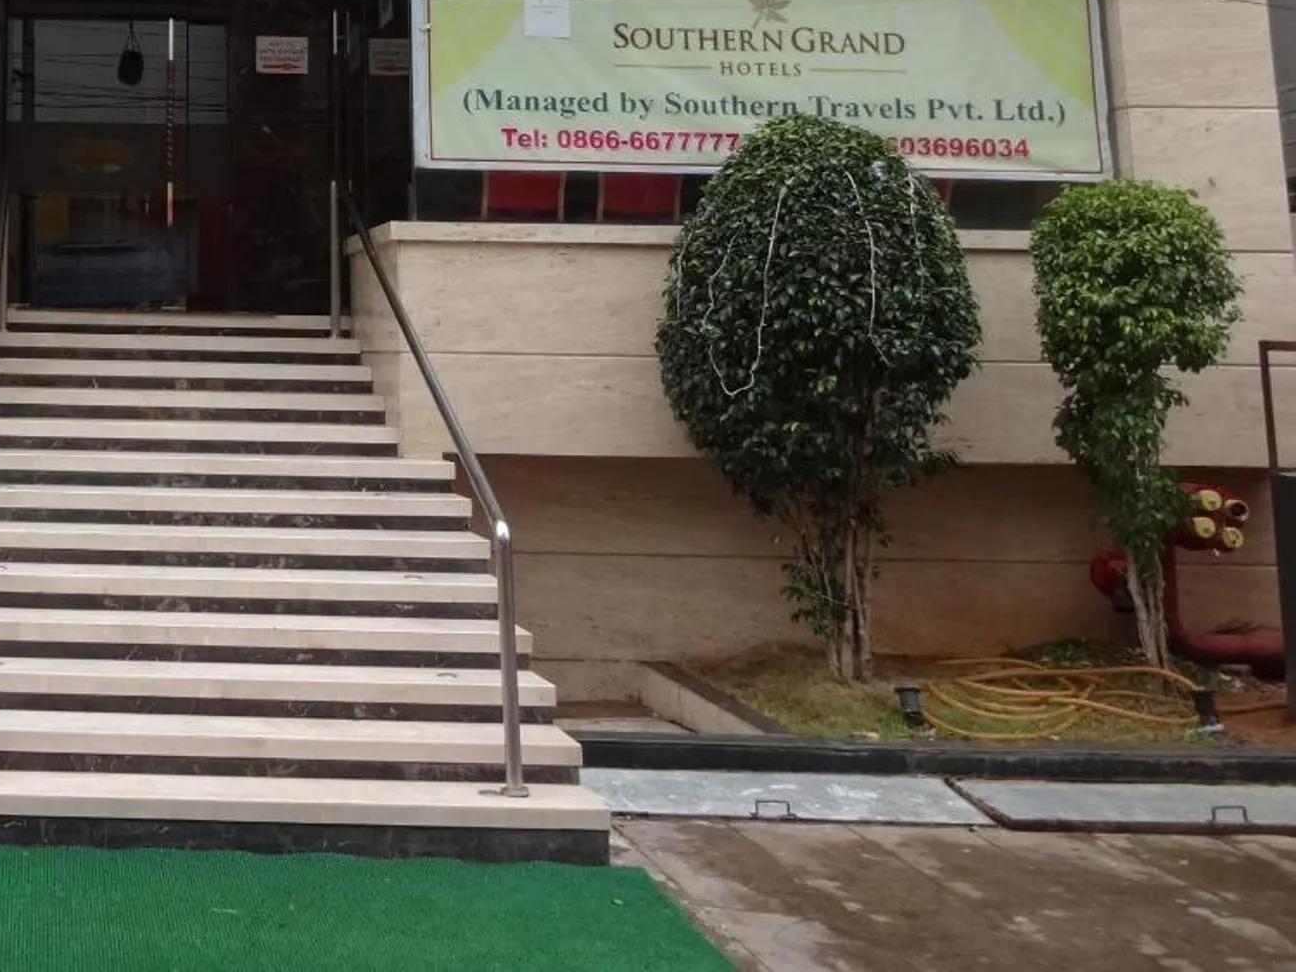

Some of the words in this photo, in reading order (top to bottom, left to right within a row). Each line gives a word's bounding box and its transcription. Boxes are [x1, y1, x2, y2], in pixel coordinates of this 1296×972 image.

[613, 22, 783, 54] SOUTHERN
[791, 26, 905, 56] GRAND
[719, 60, 802, 77] HOTELS
[462, 88, 609, 117] (Managed
[620, 90, 655, 119] by
[664, 92, 798, 117] Southern
[808, 95, 916, 120] Travels
[927, 98, 983, 121] Pvt.
[994, 98, 1066, 127] Ltd.)
[501, 128, 548, 149] Tel:
